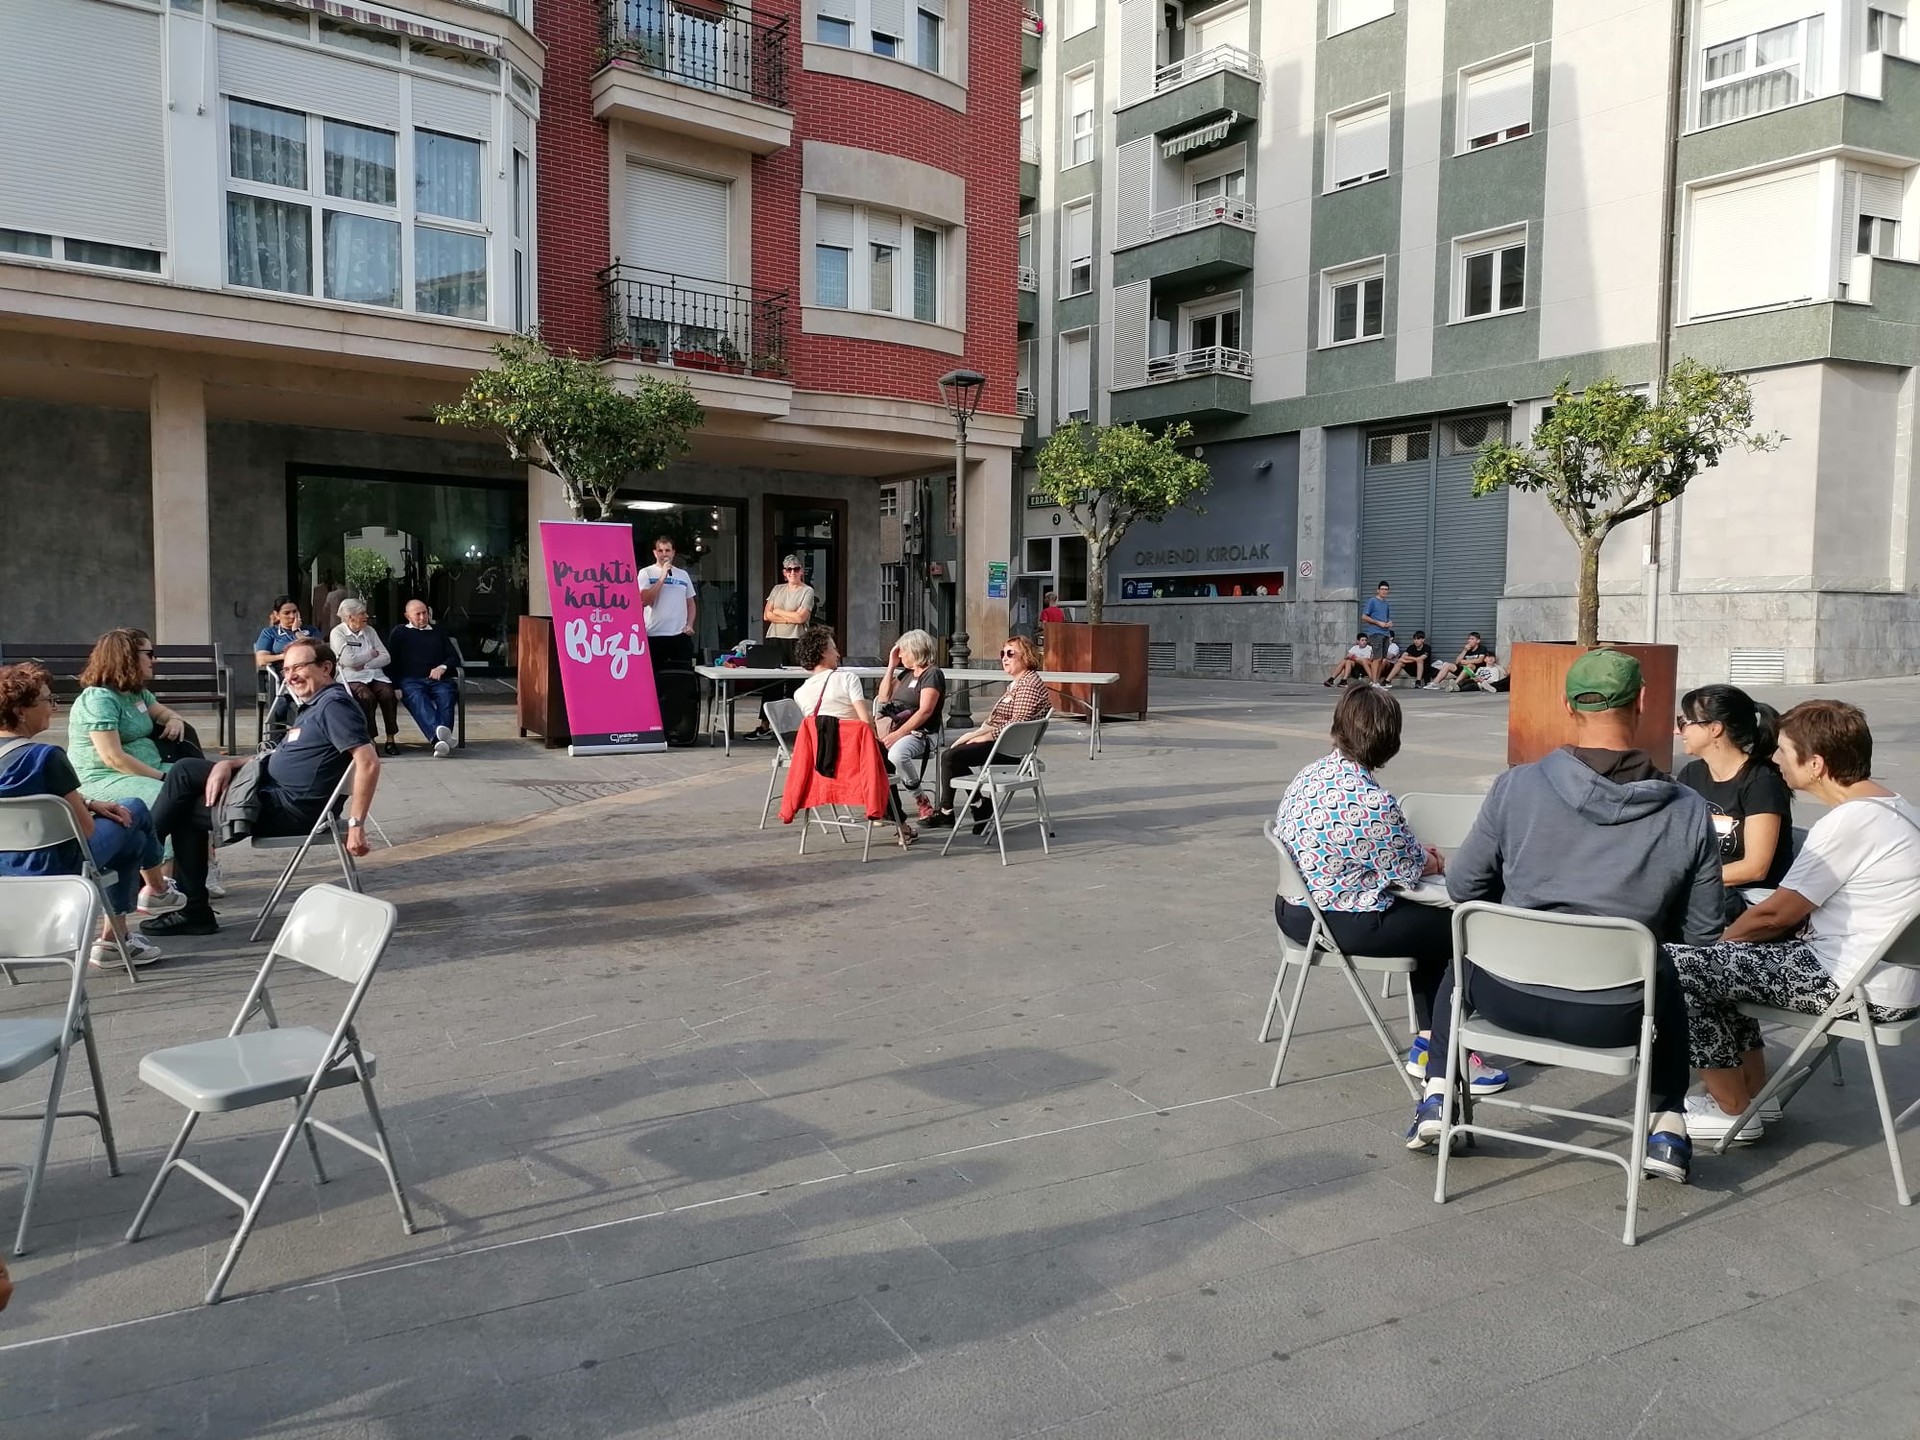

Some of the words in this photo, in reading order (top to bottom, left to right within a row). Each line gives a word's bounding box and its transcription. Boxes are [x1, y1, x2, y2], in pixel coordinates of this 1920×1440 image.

[1053, 513, 1060, 525] 3
[1135, 549, 1200, 567] ORMENDI
[1206, 543, 1271, 563] KIROLAK
[590, 608, 613, 624] eta
[564, 618, 645, 680] Bizi
